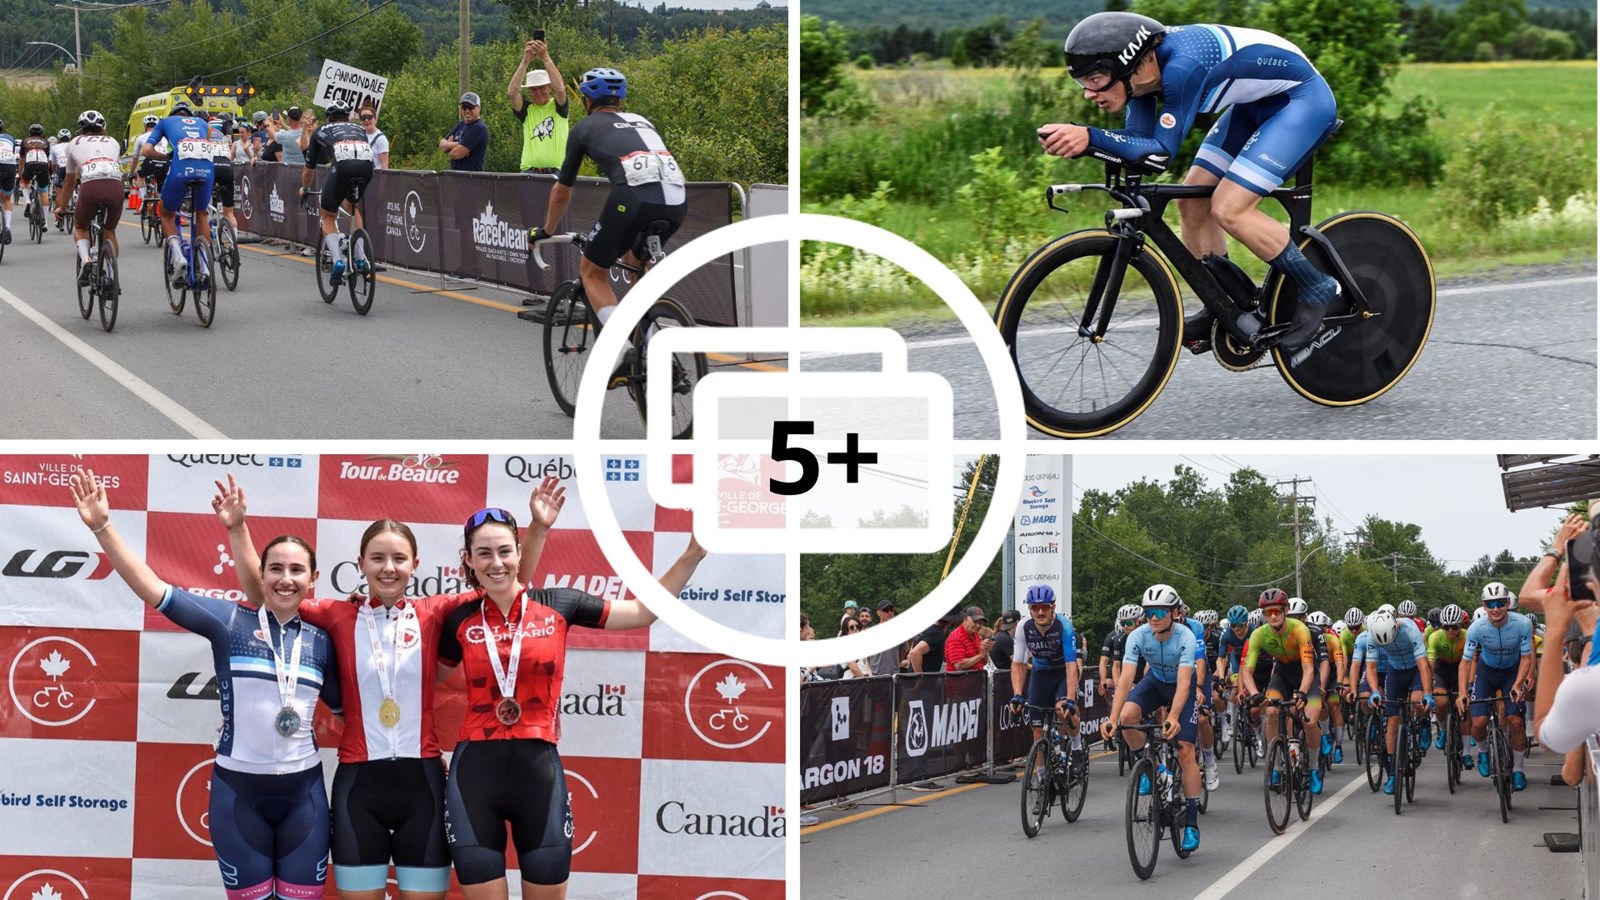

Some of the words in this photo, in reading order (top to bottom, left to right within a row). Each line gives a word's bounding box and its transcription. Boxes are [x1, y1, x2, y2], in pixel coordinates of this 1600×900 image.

[1256, 57, 1289, 67] QUÉBEC
[325, 66, 385, 94] CANNONDALE
[182, 142, 194, 152] 50
[339, 144, 349, 153] 14
[87, 163, 97, 172] 19
[633, 156, 649, 171] 67
[472, 217, 529, 251] RaceClean
[39, 463, 66, 472] VILLE
[340, 461, 379, 480] Tour
[387, 463, 459, 484] Beauce
[4, 471, 120, 488] SAINT-GEOGES
[749, 491, 762, 501] DE
[1032, 516, 1057, 524] MAPEI
[1019, 542, 1059, 555] Canada
[723, 588, 753, 602] Self
[931, 698, 983, 748] MAPEI
[863, 753, 885, 776] 18
[36, 794, 67, 807] Self
[69, 795, 128, 812] Storage
[656, 801, 787, 838] Canada
